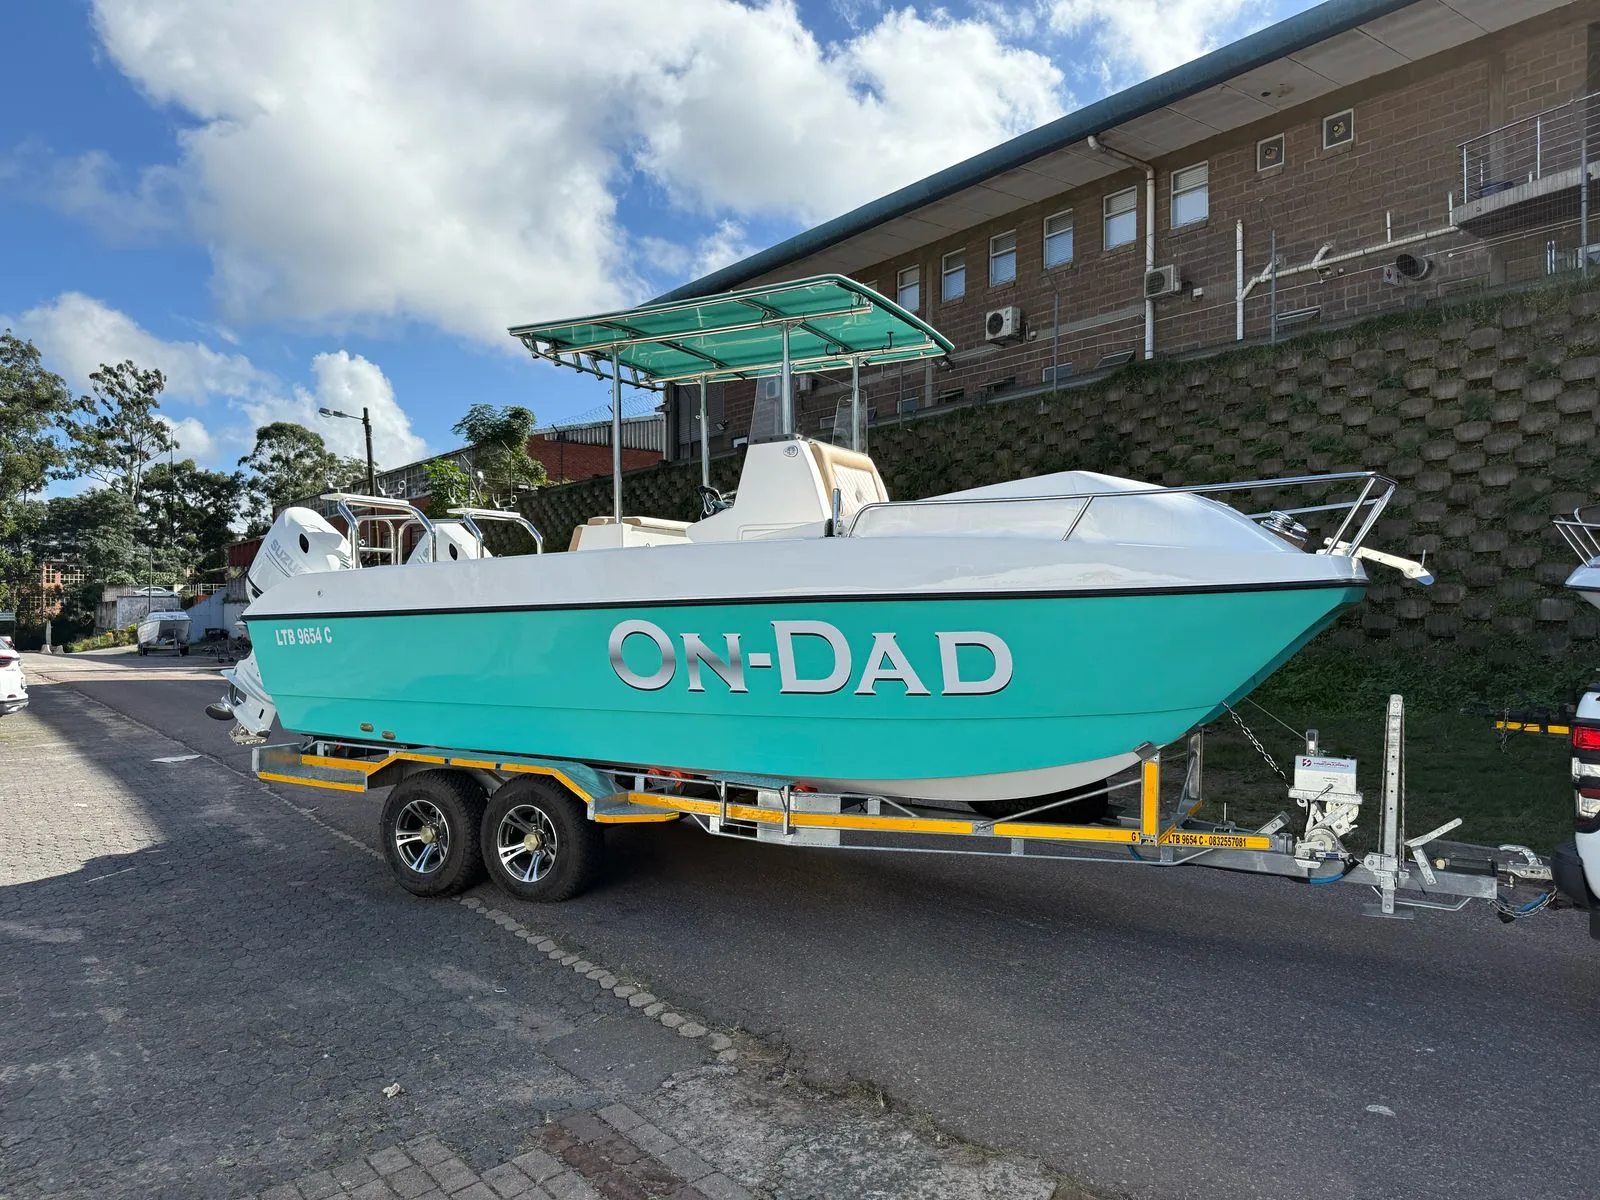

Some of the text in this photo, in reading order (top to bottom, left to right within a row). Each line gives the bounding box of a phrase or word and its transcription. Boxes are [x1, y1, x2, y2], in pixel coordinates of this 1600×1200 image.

[275, 626, 333, 646] LTB 9654 C
[1168, 834, 1181, 844] LTB
[1181, 835, 1198, 845] 9654
[1198, 835, 1204, 845] C
